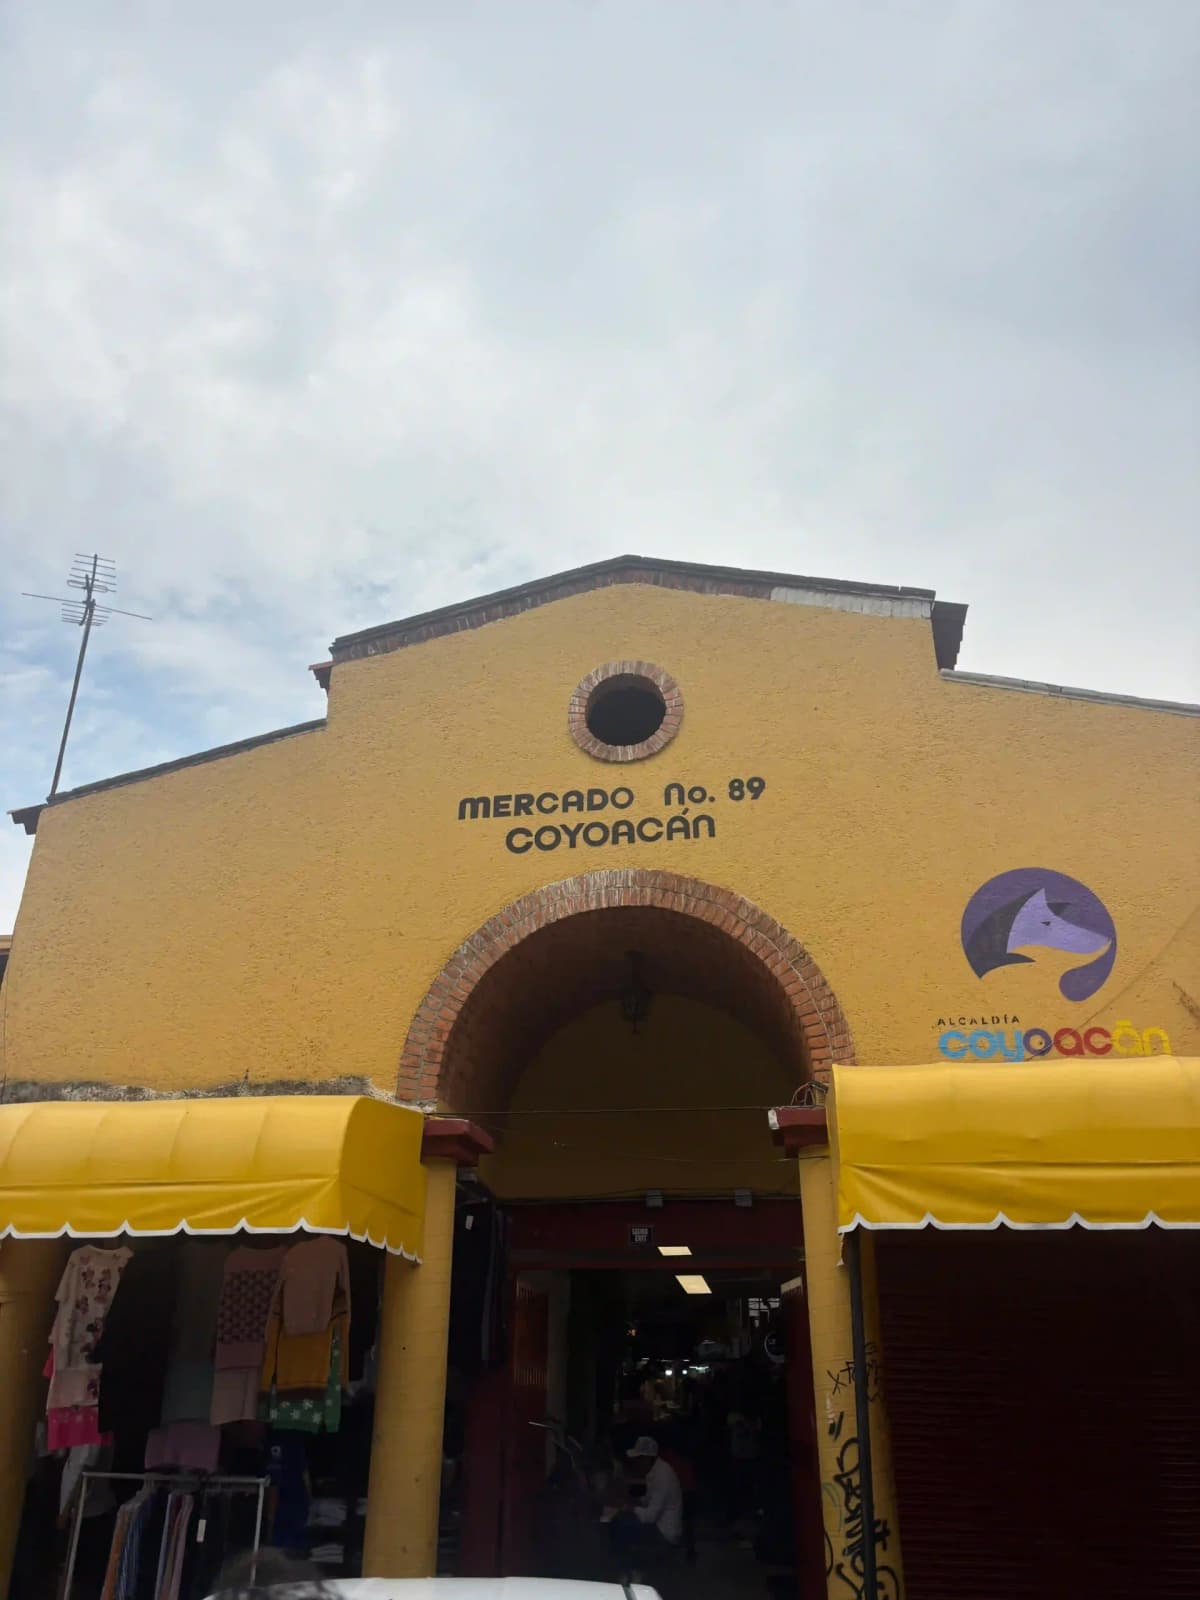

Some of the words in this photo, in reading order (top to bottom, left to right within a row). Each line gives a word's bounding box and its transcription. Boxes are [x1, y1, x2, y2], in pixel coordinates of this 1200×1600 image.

[458, 787, 634, 820] MERCADO
[664, 782, 716, 806] No.
[728, 776, 766, 801] 89
[505, 807, 716, 854] COYOACÁN
[937, 1015, 1020, 1027] ALCALDÍA
